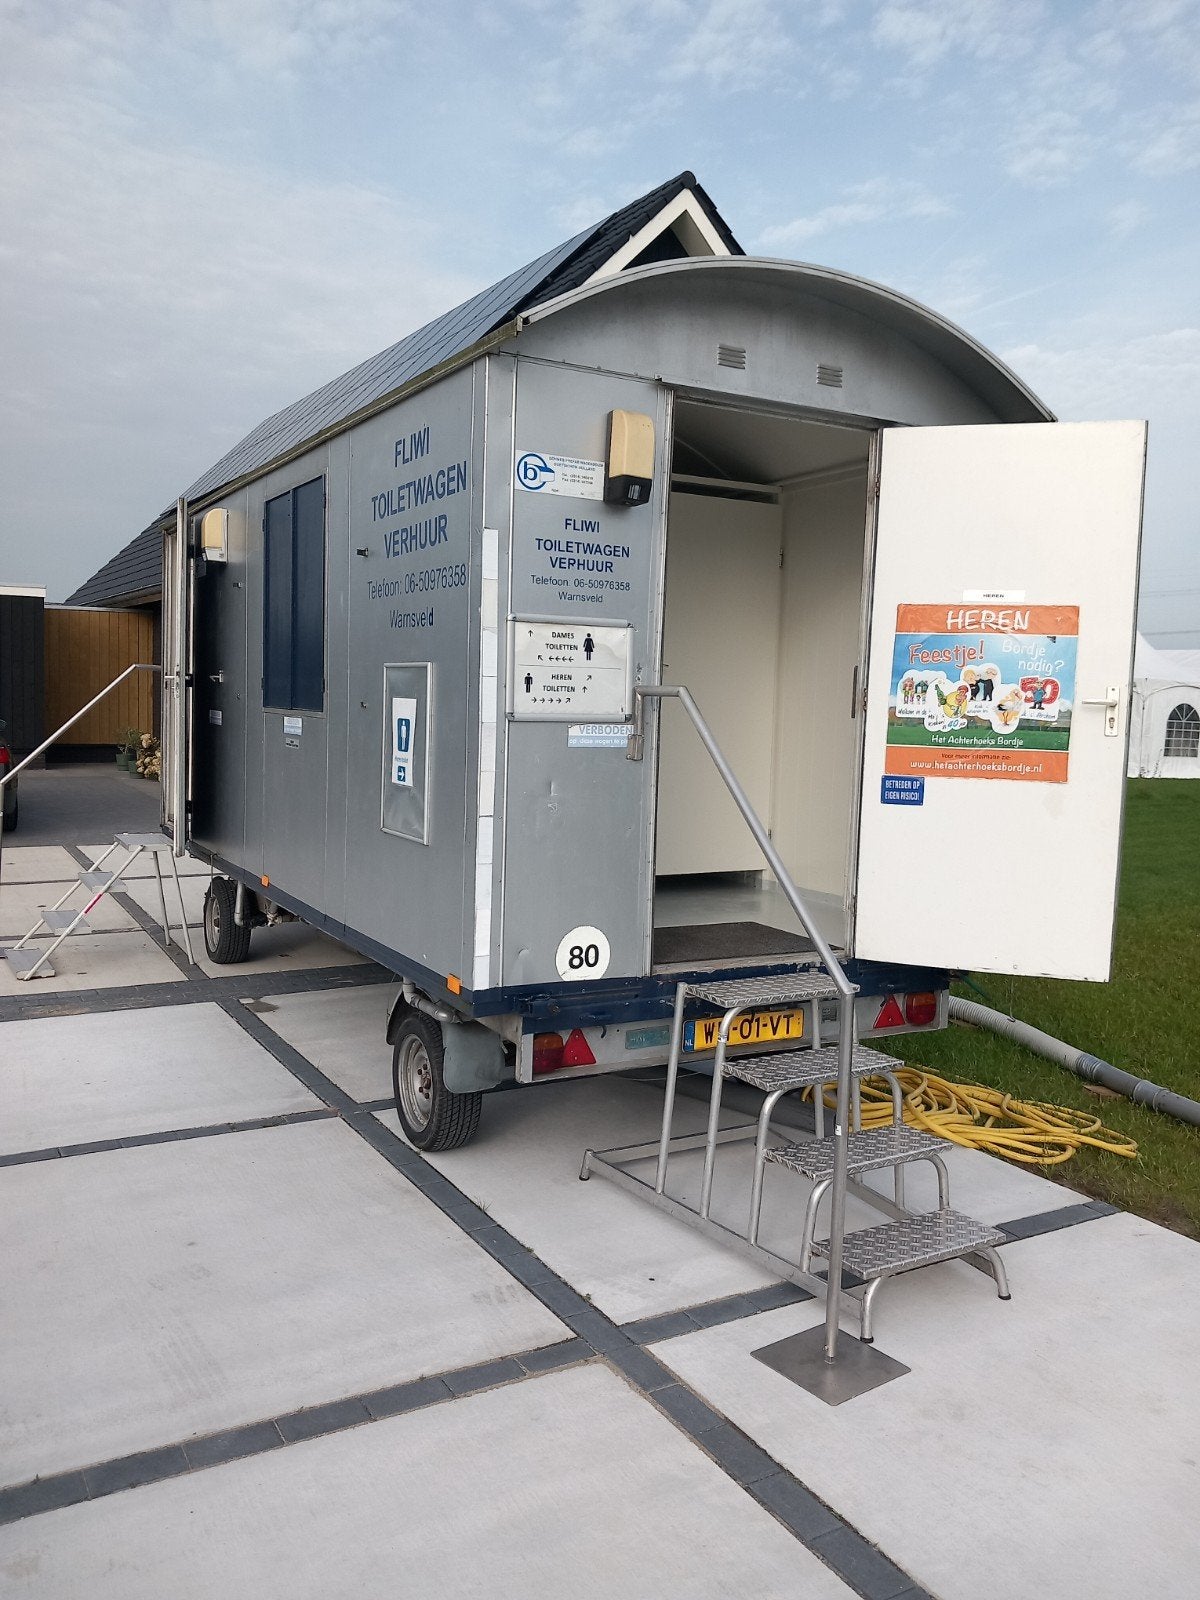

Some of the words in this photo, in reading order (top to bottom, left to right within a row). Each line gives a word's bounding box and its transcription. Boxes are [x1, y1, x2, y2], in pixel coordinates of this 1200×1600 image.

[394, 426, 430, 468] FLIWI
[371, 460, 467, 522] TOILETWAGEN
[564, 518, 600, 533] FLIWI
[384, 514, 448, 559] VERHUUR
[535, 538, 630, 558] TOILETWAGEN
[549, 556, 614, 573] VERHUUR
[367, 578, 402, 601] Telefoon:
[404, 563, 467, 595] 06-50976358
[531, 574, 570, 587] Telefoon:
[573, 578, 631, 592] 06-50976358
[558, 591, 603, 603] Warnsveld
[389, 606, 434, 629] Warnsveld
[946, 609, 1030, 632] HEREN
[551, 631, 575, 639] DAMES
[545, 643, 579, 651] TOILETTEN
[908, 639, 985, 668] Feestje!
[1002, 639, 1046, 659] Bordje
[1018, 658, 1064, 675] nodig?
[551, 673, 573, 681] HEREN
[543, 685, 576, 693] TOILETTEN
[579, 725, 633, 735] VERBODEN
[931, 735, 946, 744] Het
[947, 735, 996, 745] Achterhoeks
[997, 736, 1024, 748] Bordje
[910, 760, 1043, 774] www.hetachterhoeksbordje.nl
[885, 780, 911, 789] BETREDEN
[912, 780, 921, 790] OP
[884, 790, 900, 800] EIGEN
[900, 791, 920, 801] RISICO!
[569, 944, 599, 969] 80
[684, 1038, 694, 1047] NL
